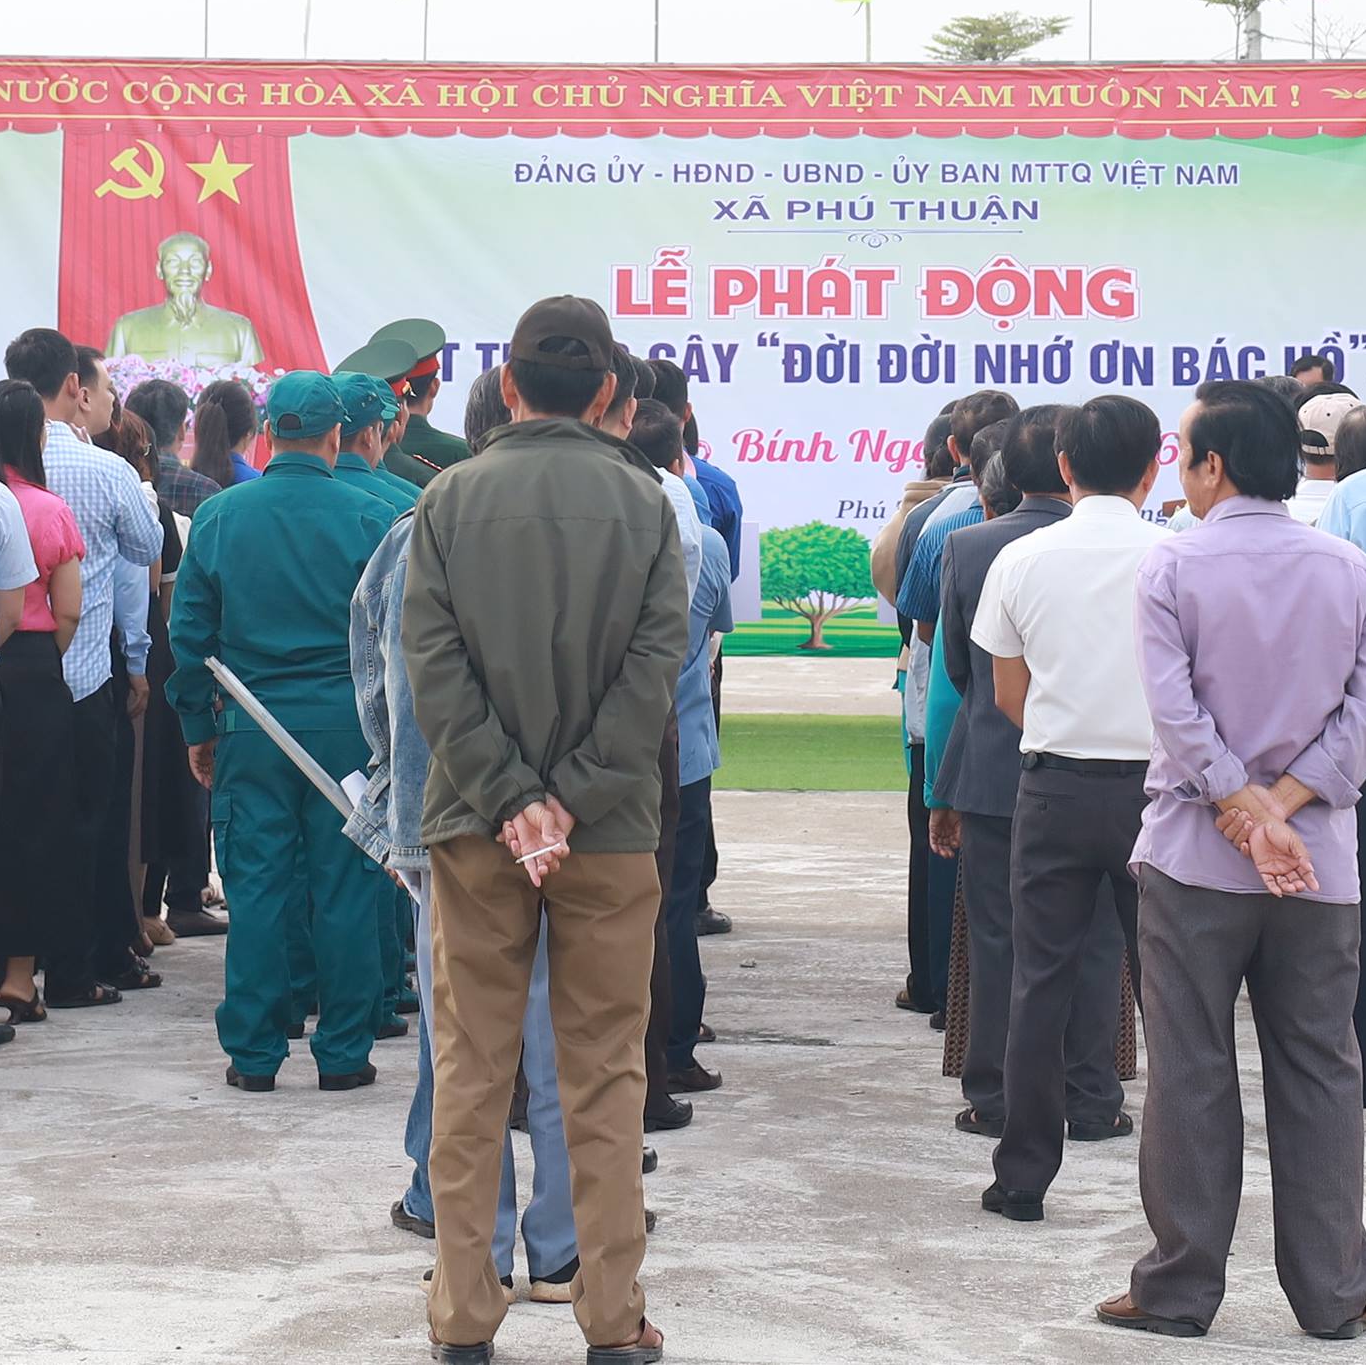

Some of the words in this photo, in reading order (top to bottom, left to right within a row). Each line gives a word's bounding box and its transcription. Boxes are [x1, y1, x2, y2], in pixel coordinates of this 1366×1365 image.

[122, 79, 247, 111] CỘNG
[261, 77, 357, 107] HÒA
[364, 80, 425, 107] XÃ
[437, 79, 518, 114] HỘI
[532, 75, 626, 108] CHỦ
[640, 79, 783, 108] NGHĨA
[796, 78, 904, 114] VIỆT
[913, 85, 1016, 107] NAM
[1027, 77, 1167, 109] MUÔN
[1177, 78, 1279, 109] NĂM
[514, 156, 598, 184] ĐẢNG
[607, 153, 647, 184] ỦY
[672, 163, 754, 184] HĐND
[782, 163, 864, 184] UBND
[891, 153, 932, 184] ỦY
[940, 163, 1000, 184] BAN
[1010, 163, 1092, 185] MTTQ
[1102, 161, 1167, 189] VIỆT
[1175, 165, 1239, 185] NAM
[712, 195, 772, 221] XÃ
[785, 195, 875, 221] PHÚ
[890, 196, 1040, 226] THUẬN
[614, 248, 692, 317] LỄ
[710, 255, 901, 317] PHÁT
[917, 253, 1139, 332] ĐỘNG
[757, 332, 860, 383] “ĐỜI
[877, 334, 955, 383] ĐỜI
[974, 336, 1076, 385] NHỚ
[1090, 339, 1154, 385] ƠN
[1172, 337, 1266, 385] BÁC
[732, 429, 839, 462] Bính
[836, 499, 885, 519] Phú
